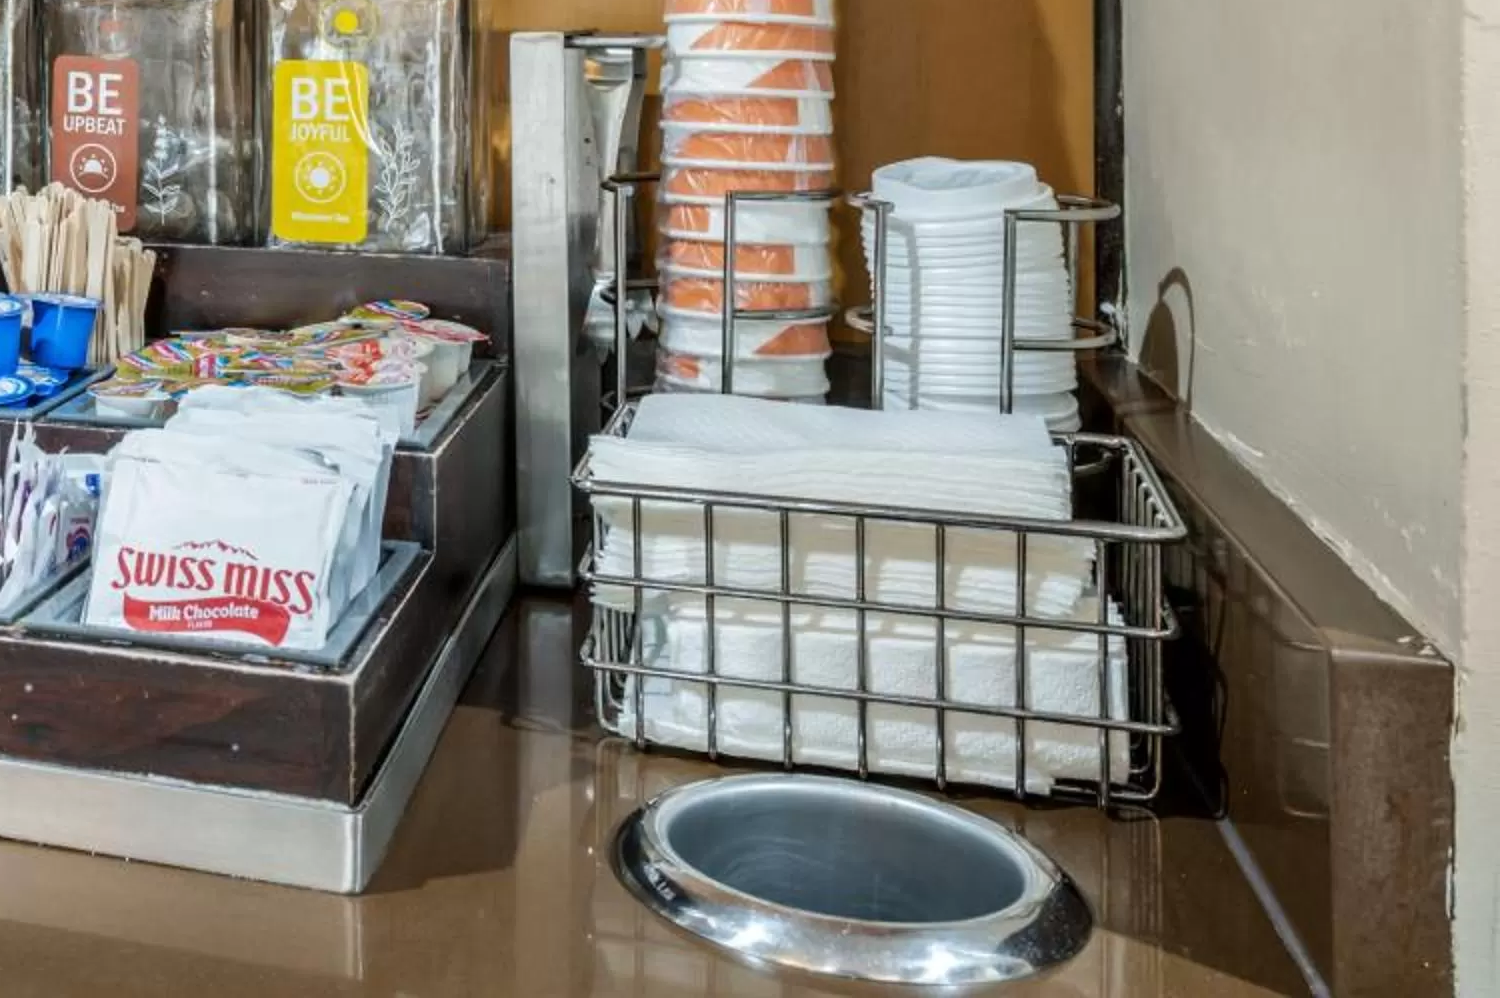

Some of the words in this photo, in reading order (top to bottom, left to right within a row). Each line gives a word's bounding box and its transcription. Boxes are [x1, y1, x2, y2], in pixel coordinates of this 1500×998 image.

[67, 71, 124, 115] BE
[291, 77, 351, 122] BE
[63, 114, 127, 134] UPBEAT
[290, 121, 352, 143] JOYFUL
[111, 546, 216, 592] SWISS
[149, 604, 181, 622] Milk
[183, 602, 260, 620] Chocolate
